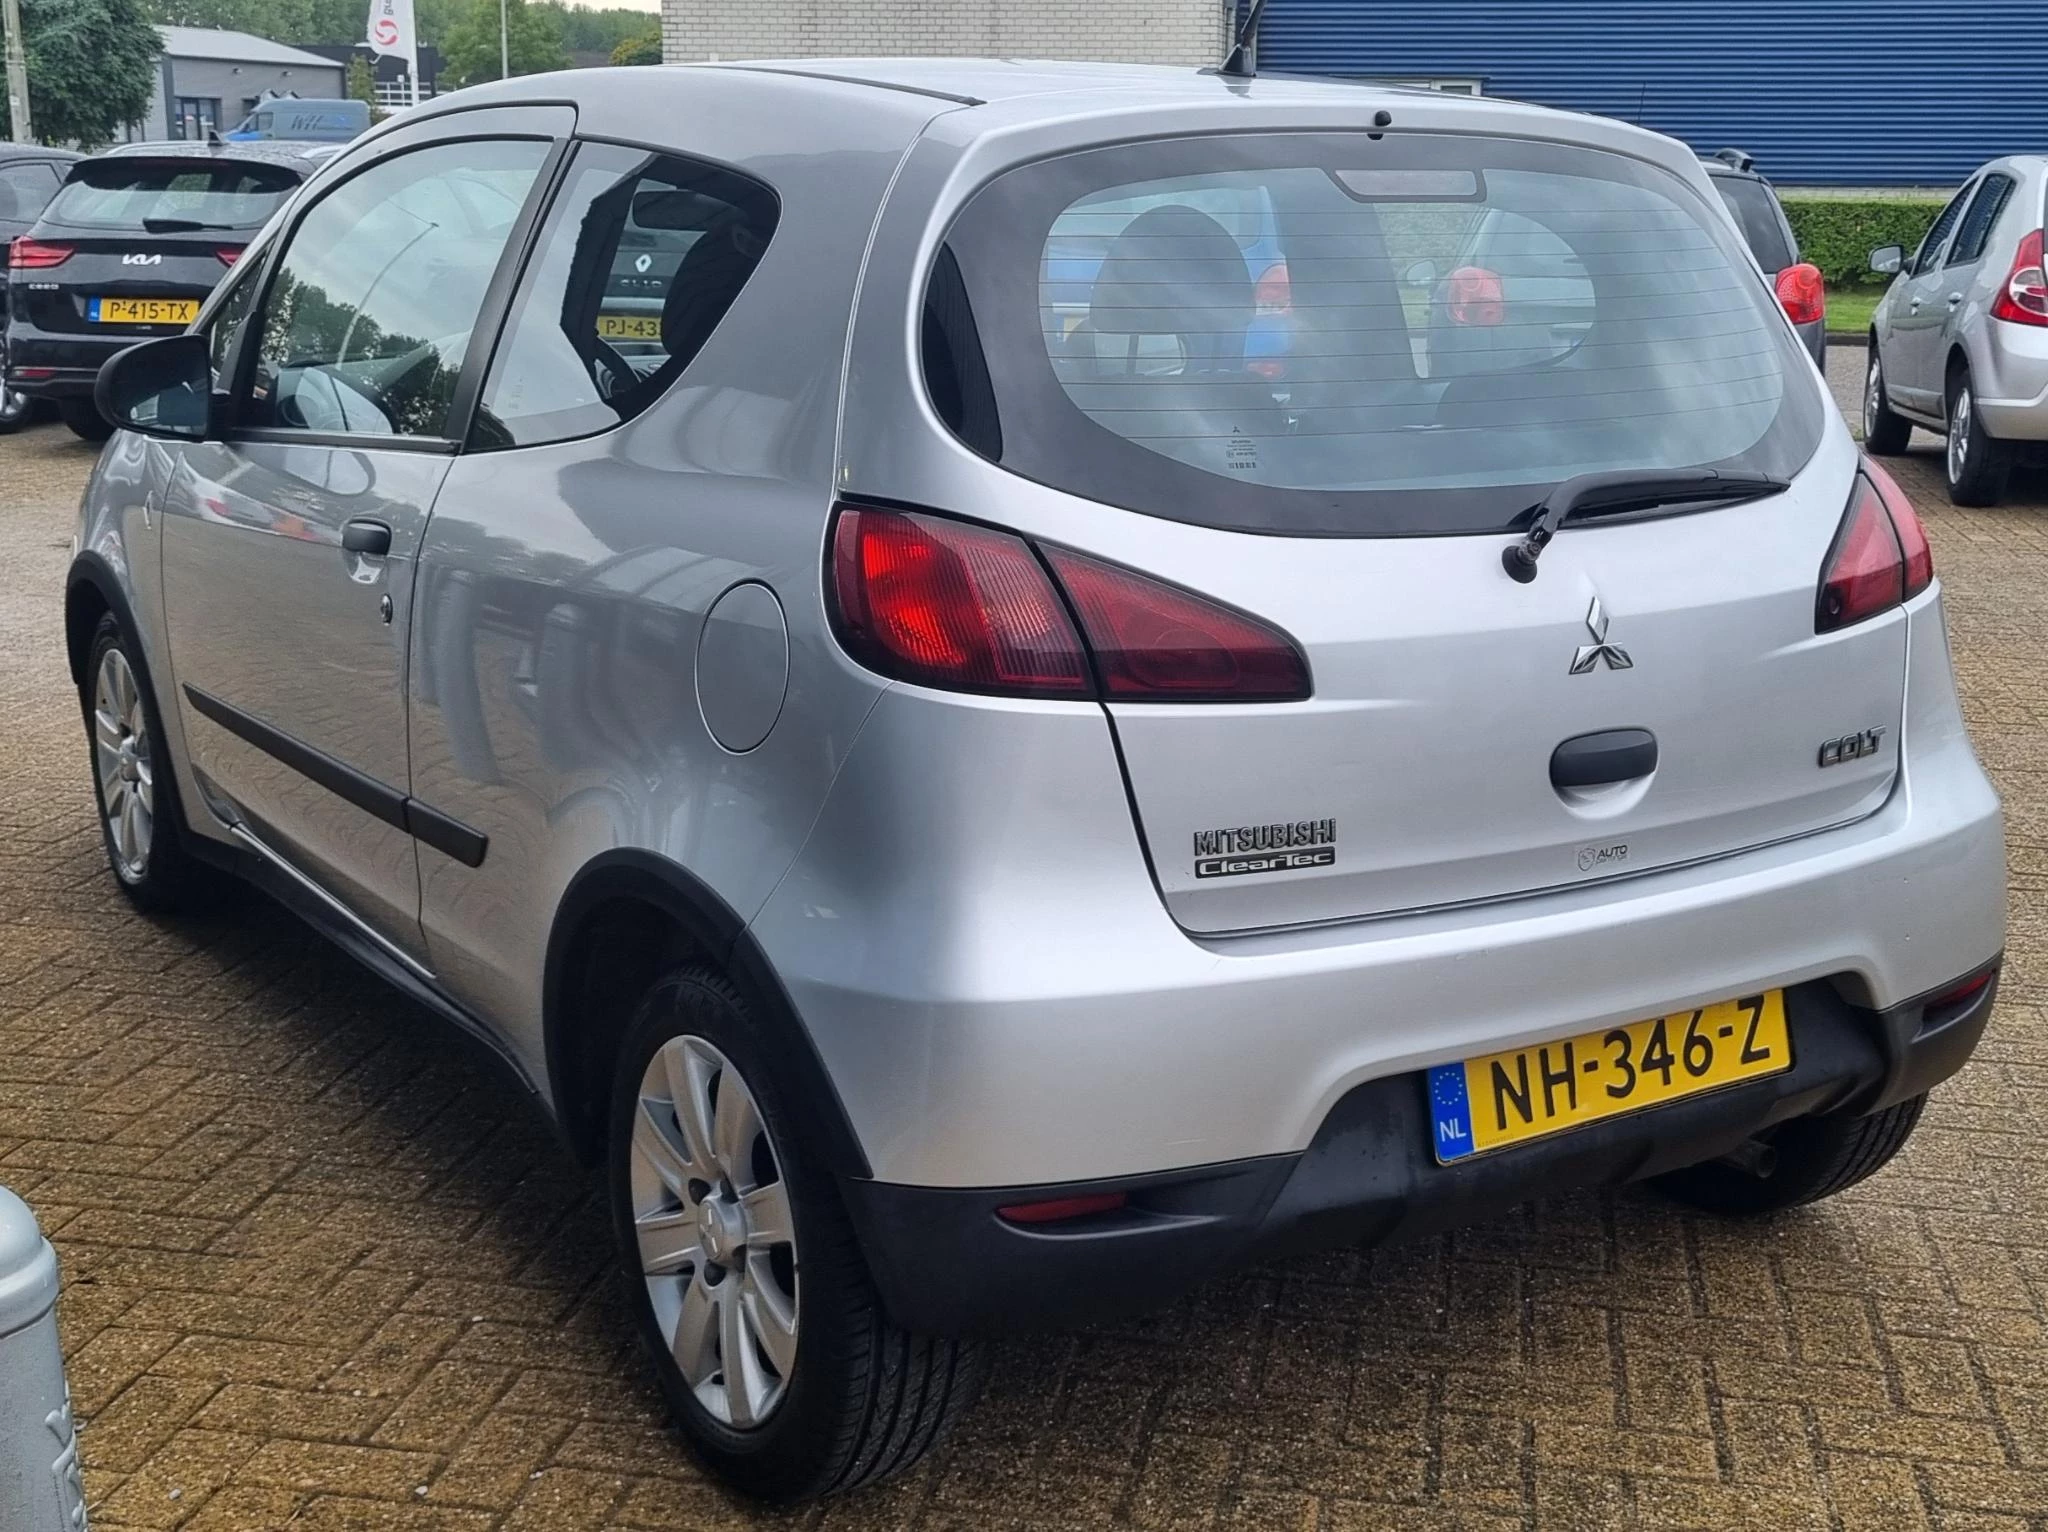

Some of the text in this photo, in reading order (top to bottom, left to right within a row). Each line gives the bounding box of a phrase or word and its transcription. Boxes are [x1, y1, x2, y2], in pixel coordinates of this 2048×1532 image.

[606, 319, 662, 337] PJ-43
[1818, 725, 1887, 769] COLT
[1194, 818, 1337, 857] MITSUBISHI
[1199, 852, 1332, 876] ClearTec
[1597, 844, 1628, 860] AUTO
[1490, 994, 1771, 1131] NH-346-Z
[1439, 1119, 1467, 1142] NL
